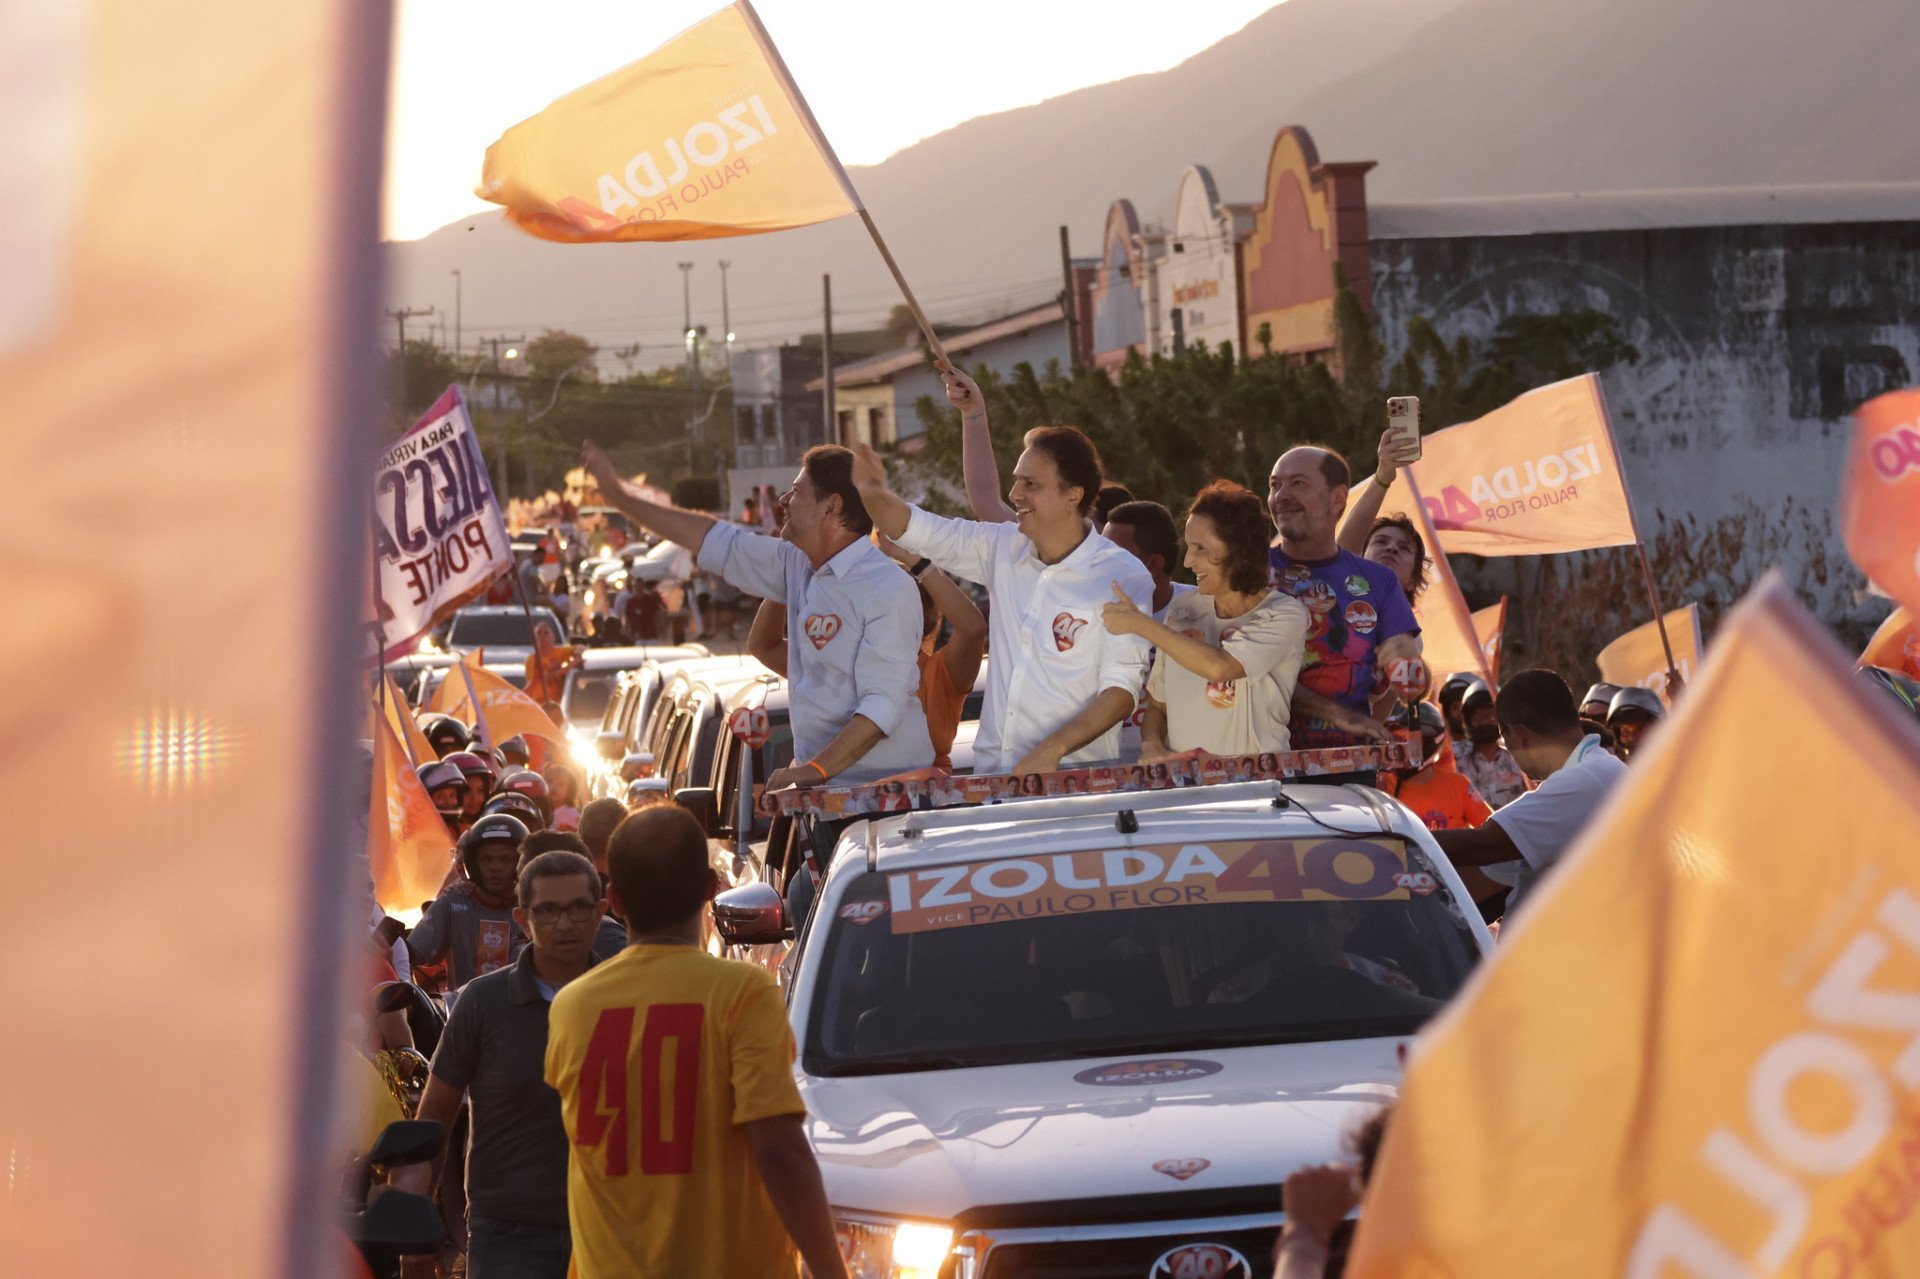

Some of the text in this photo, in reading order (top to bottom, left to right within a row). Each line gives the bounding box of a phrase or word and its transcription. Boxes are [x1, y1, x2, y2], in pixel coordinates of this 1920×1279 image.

[808, 616, 838, 639] 40
[1391, 660, 1425, 685] 40
[732, 710, 769, 736] 40
[889, 840, 1404, 913] IZOLDA 40
[1397, 872, 1432, 888] 40
[841, 902, 885, 918] 40
[926, 884, 1208, 925] VICE PAULO FLOR
[1095, 1067, 1208, 1082] IZOLDA
[575, 1003, 704, 1177] 40
[1157, 1158, 1203, 1174] 40
[1176, 1250, 1224, 1279] 40
